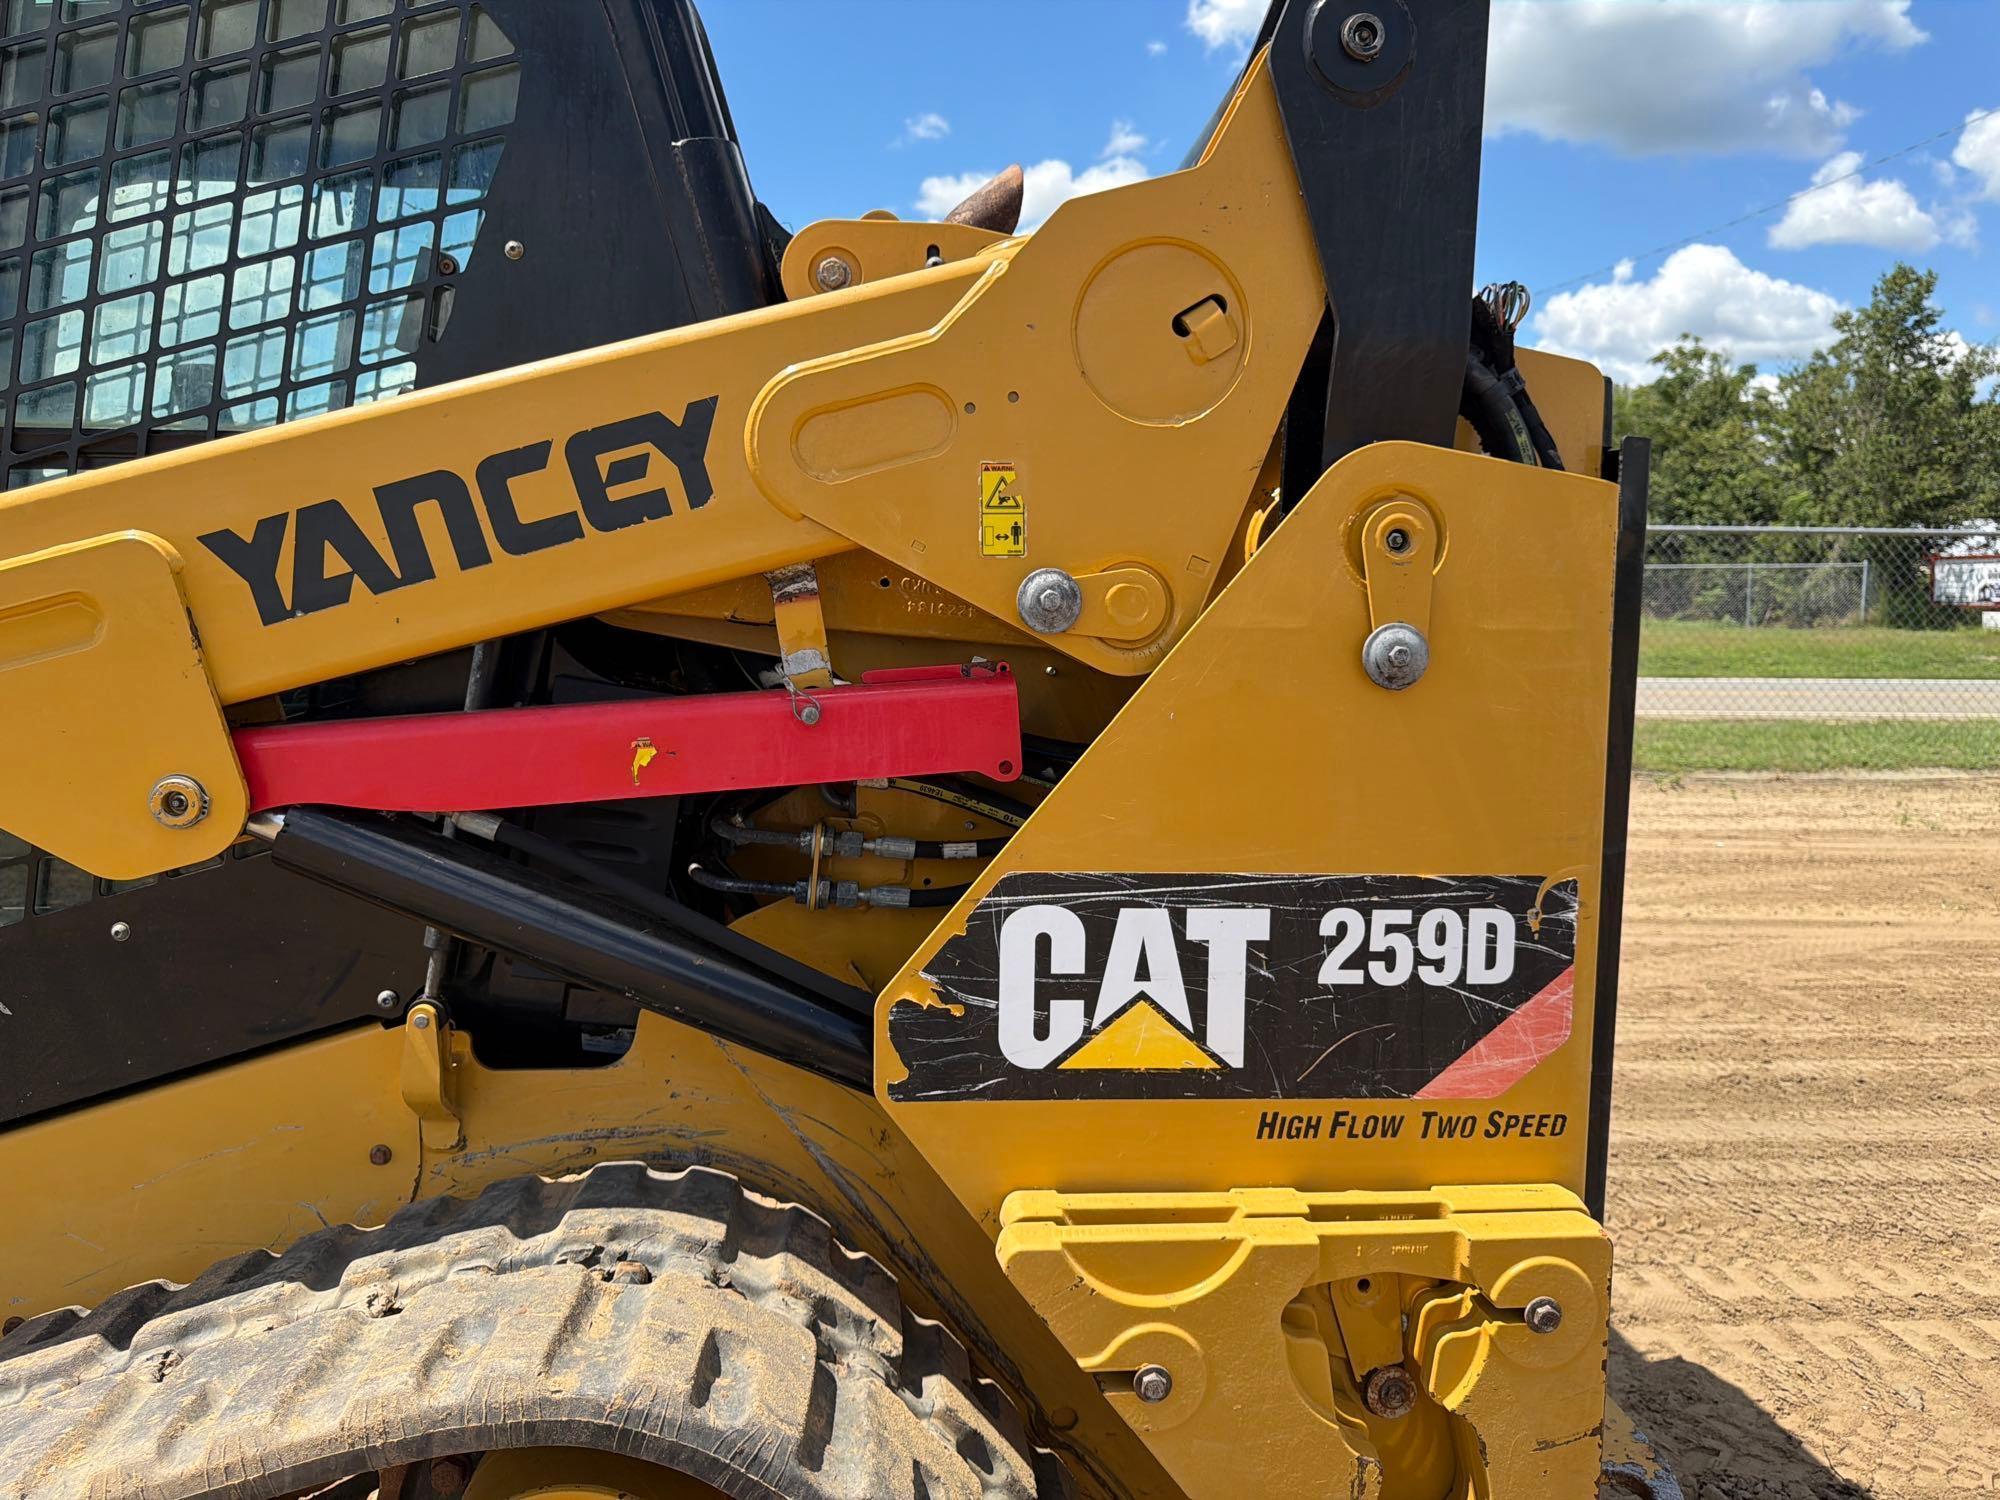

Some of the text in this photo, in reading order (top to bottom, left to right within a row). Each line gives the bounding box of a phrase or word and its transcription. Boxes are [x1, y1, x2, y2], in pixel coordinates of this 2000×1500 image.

[198, 395, 719, 627] YANCEY
[998, 904, 1518, 1070] CAT 259D
